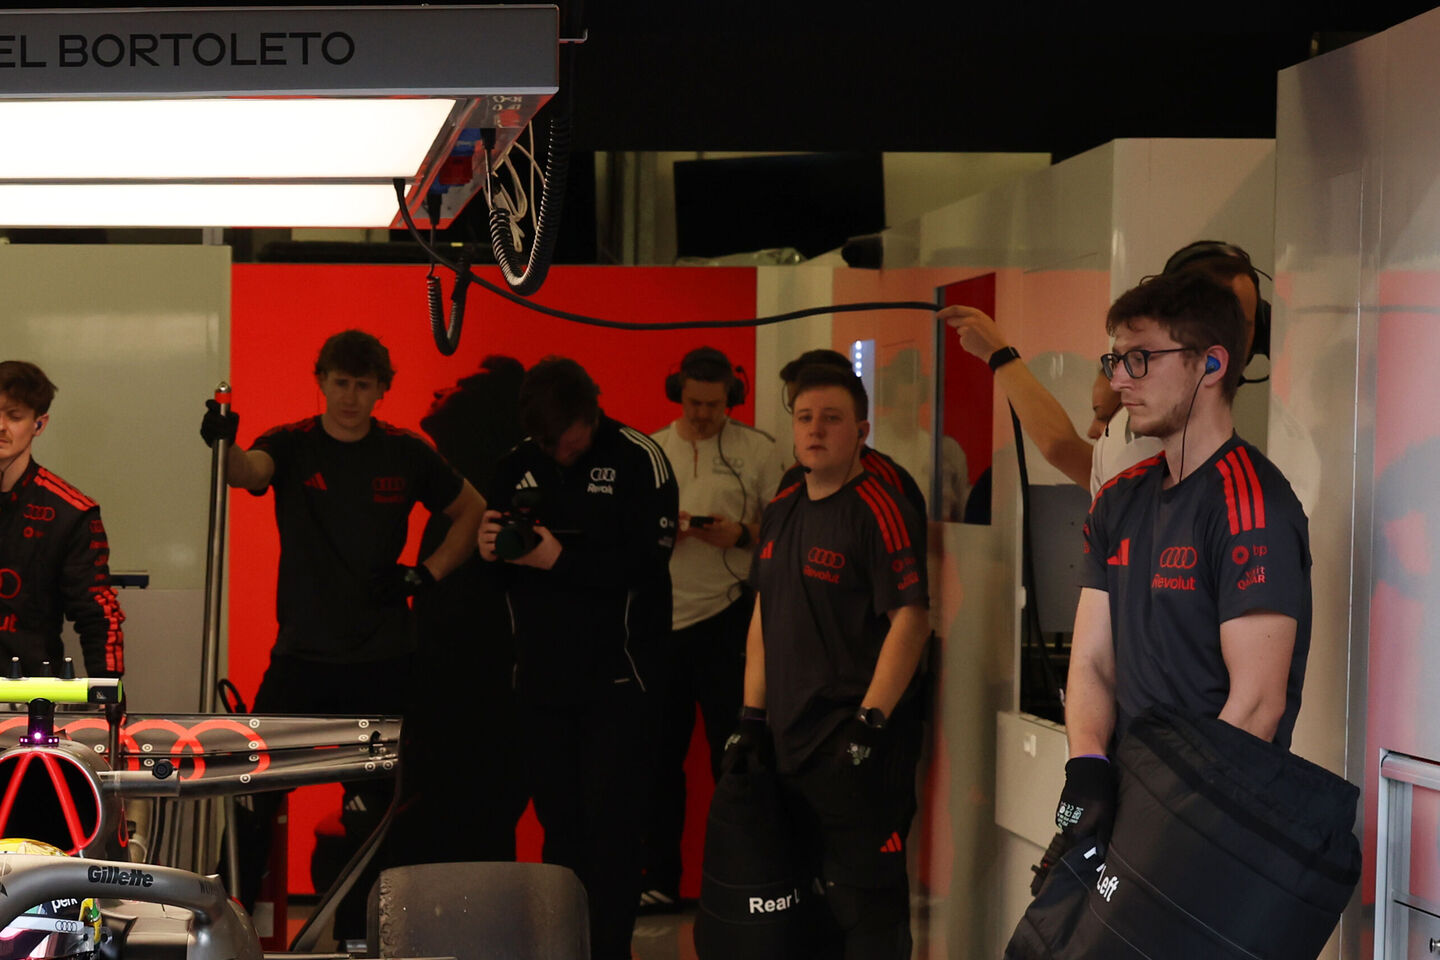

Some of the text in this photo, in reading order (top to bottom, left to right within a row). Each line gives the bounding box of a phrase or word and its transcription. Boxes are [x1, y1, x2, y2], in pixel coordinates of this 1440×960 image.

[58, 31, 356, 68] BORTOLETO
[87, 864, 154, 888] Gillette
[749, 893, 792, 914] Rear
